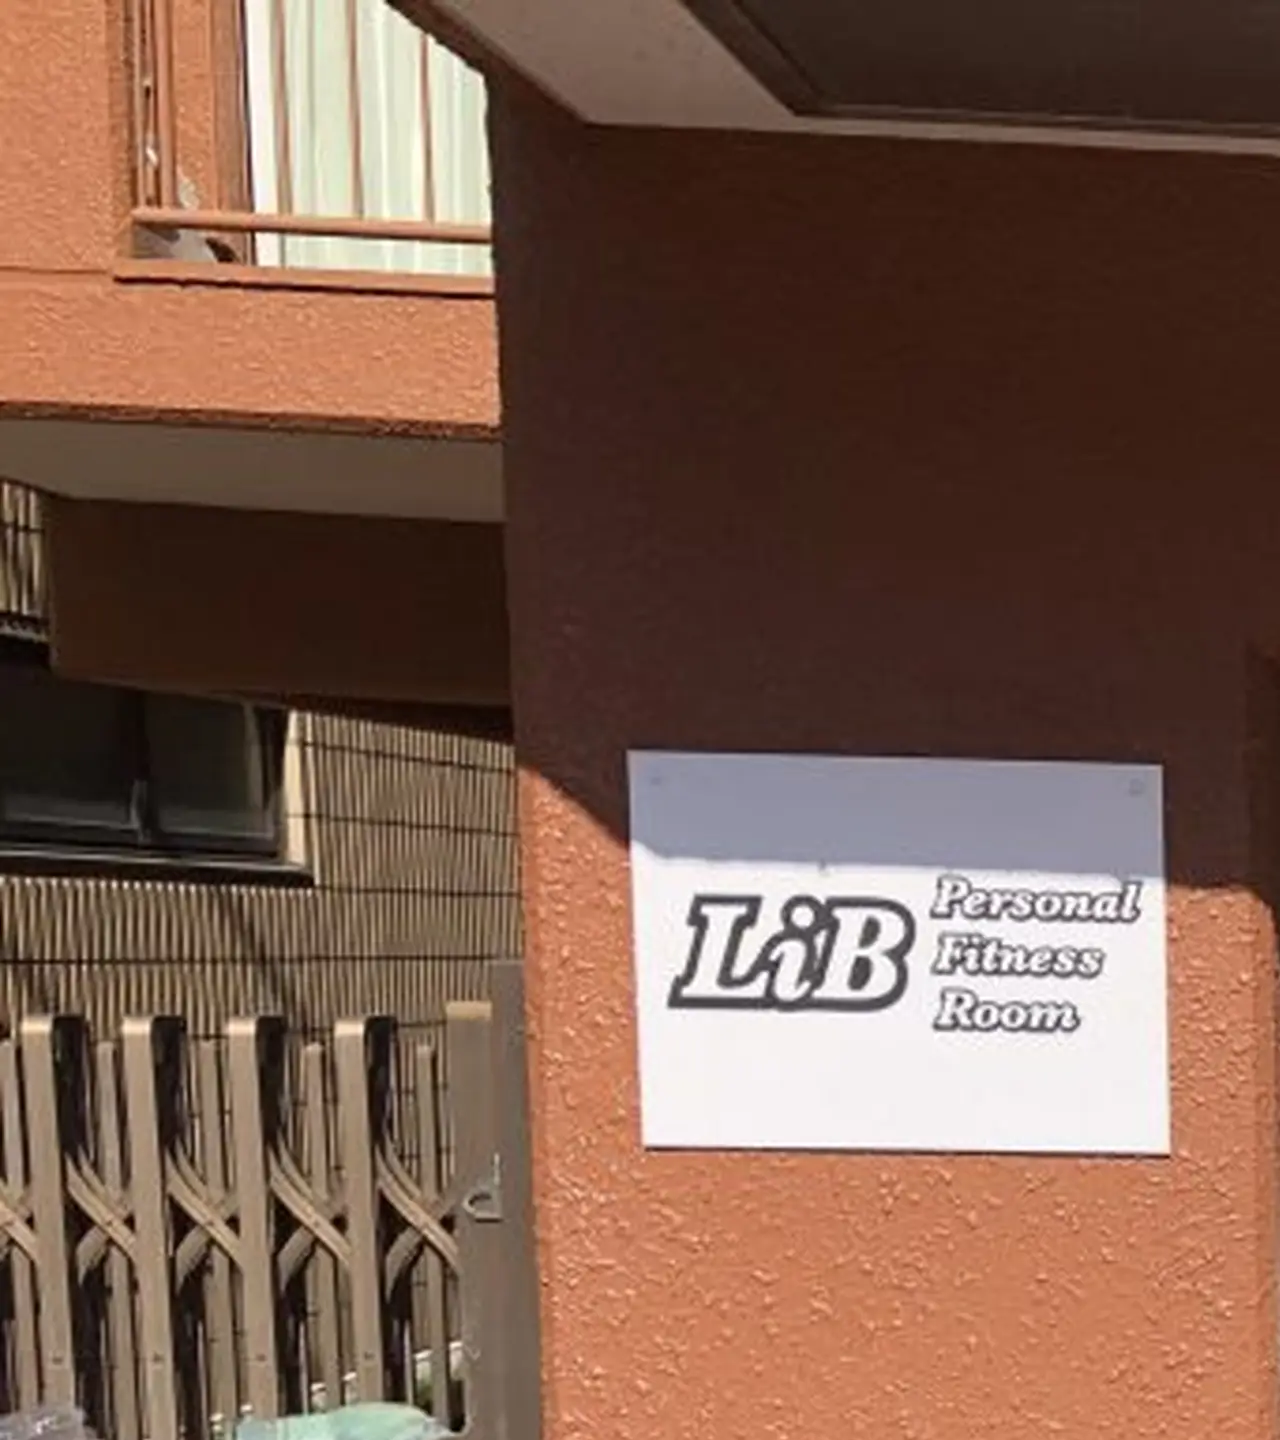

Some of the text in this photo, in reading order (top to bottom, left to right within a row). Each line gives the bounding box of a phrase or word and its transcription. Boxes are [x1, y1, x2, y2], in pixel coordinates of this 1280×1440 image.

[930, 875, 1142, 922] Personal
[668, 894, 916, 1012] LiB
[931, 933, 1104, 977] Fitness
[934, 987, 1080, 1031] Room
